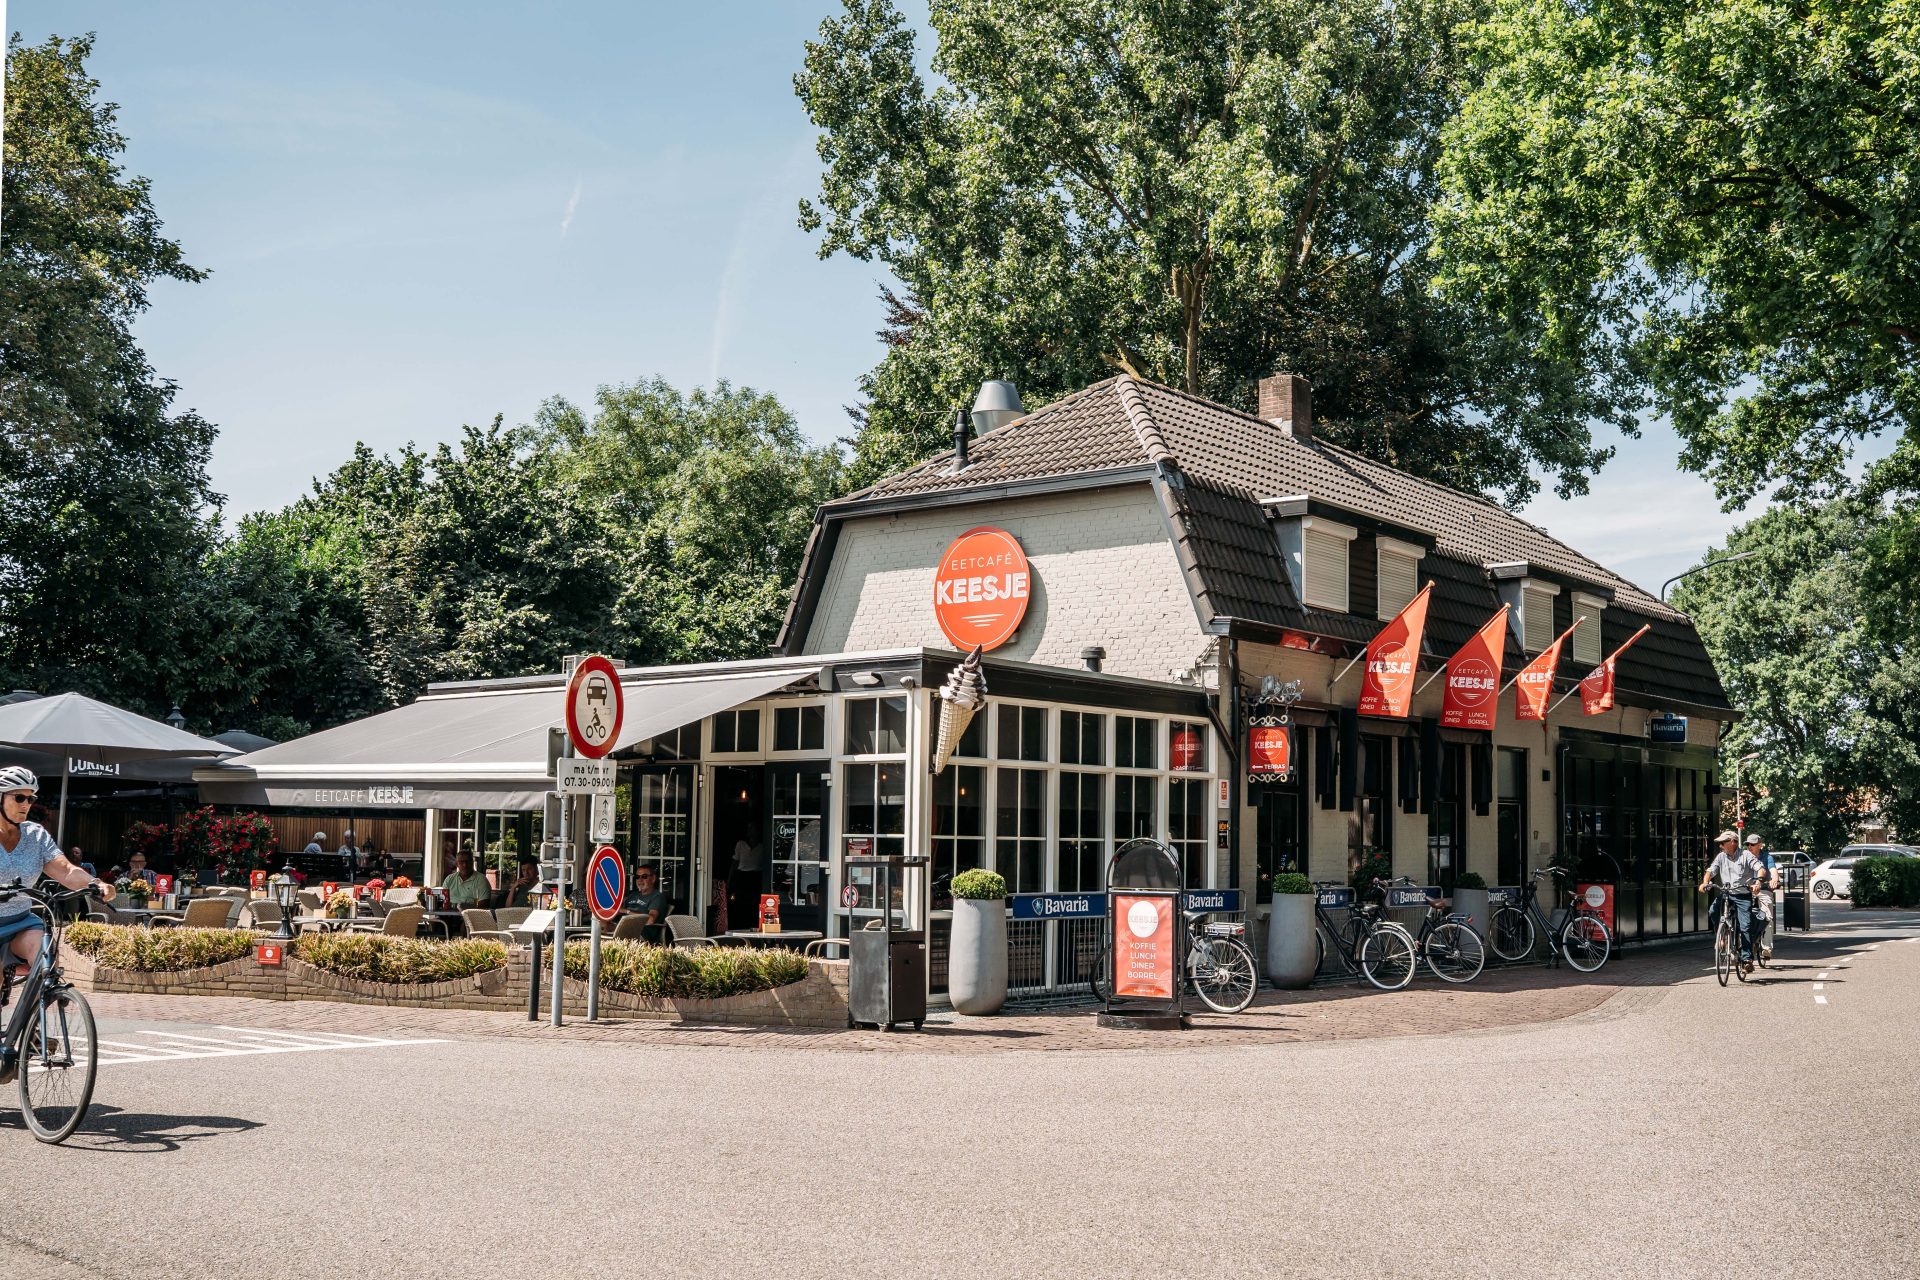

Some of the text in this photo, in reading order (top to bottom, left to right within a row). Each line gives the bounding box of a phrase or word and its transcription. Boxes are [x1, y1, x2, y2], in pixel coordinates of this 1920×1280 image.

[951, 551, 1013, 571] EETCAFÉ
[936, 572, 1027, 605] KEESJE
[1368, 660, 1412, 674] KEESJE
[1449, 676, 1495, 690] KEESJE
[1653, 723, 1684, 731] Bavaria
[1254, 740, 1283, 749] KEESJE
[574, 764, 609, 775] ma t/m vr
[315, 786, 414, 804] EETCAFÉ KEESJE
[601, 822, 608, 830] 79
[779, 825, 796, 836] Open
[1188, 893, 1223, 909] Bavaria
[1399, 890, 1427, 904] Bavaria
[1045, 896, 1089, 914] Bavaria
[1129, 942, 1157, 950] KOFFIE
[1130, 952, 1156, 960] LUNCH
[1127, 971, 1158, 980] BORREL
